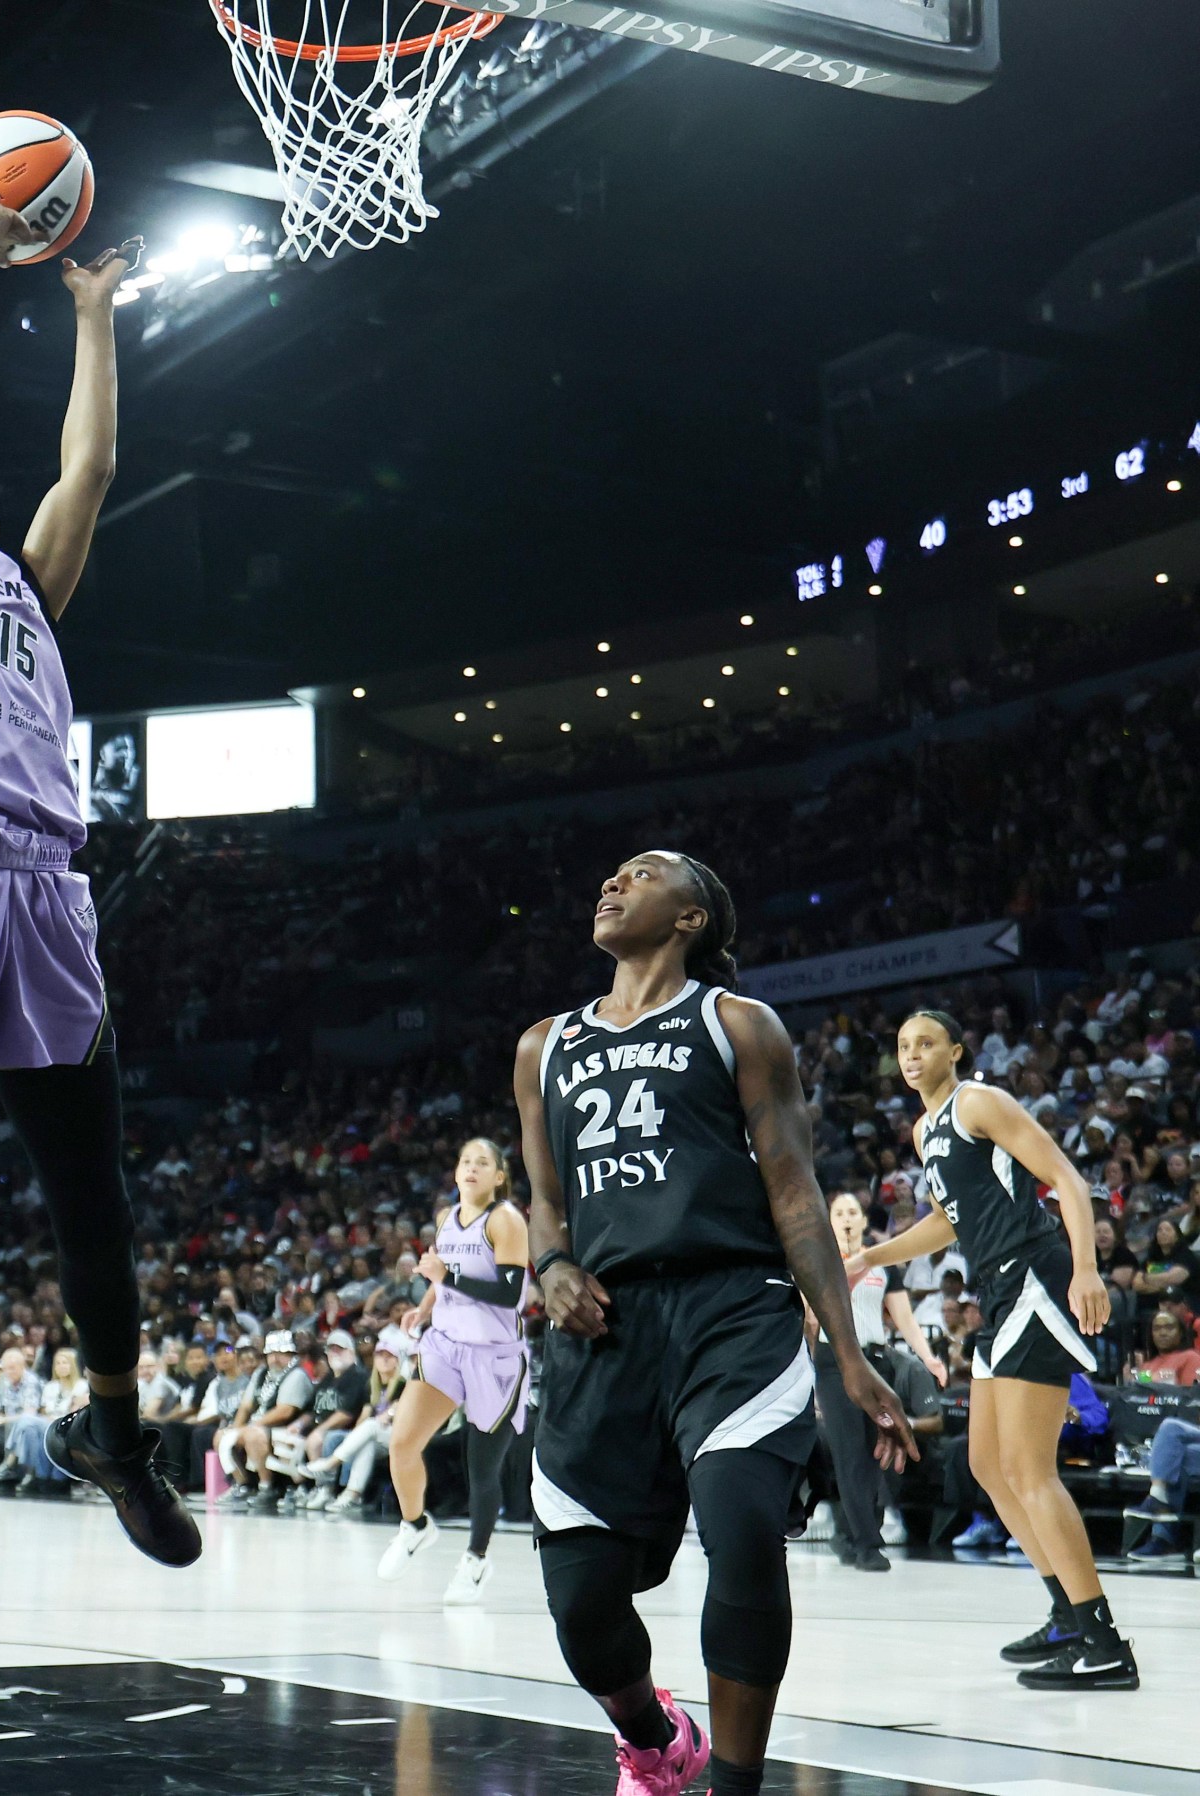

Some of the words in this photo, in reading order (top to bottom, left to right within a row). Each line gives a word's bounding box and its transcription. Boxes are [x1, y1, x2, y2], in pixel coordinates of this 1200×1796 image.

[588, 6, 738, 53] IPSY
[749, 44, 891, 89] IPSY
[919, 519, 947, 550] 40
[987, 487, 1034, 527] 3:53
[1061, 471, 1089, 499] 3rd
[1114, 446, 1146, 480] 62
[658, 1017, 691, 1031] ally
[556, 1053, 605, 1098] LAS
[606, 1042, 693, 1072] VEGAS
[573, 1078, 665, 1150] 24
[576, 1148, 675, 1199] IPSY
[456, 1243, 482, 1256] STATE
